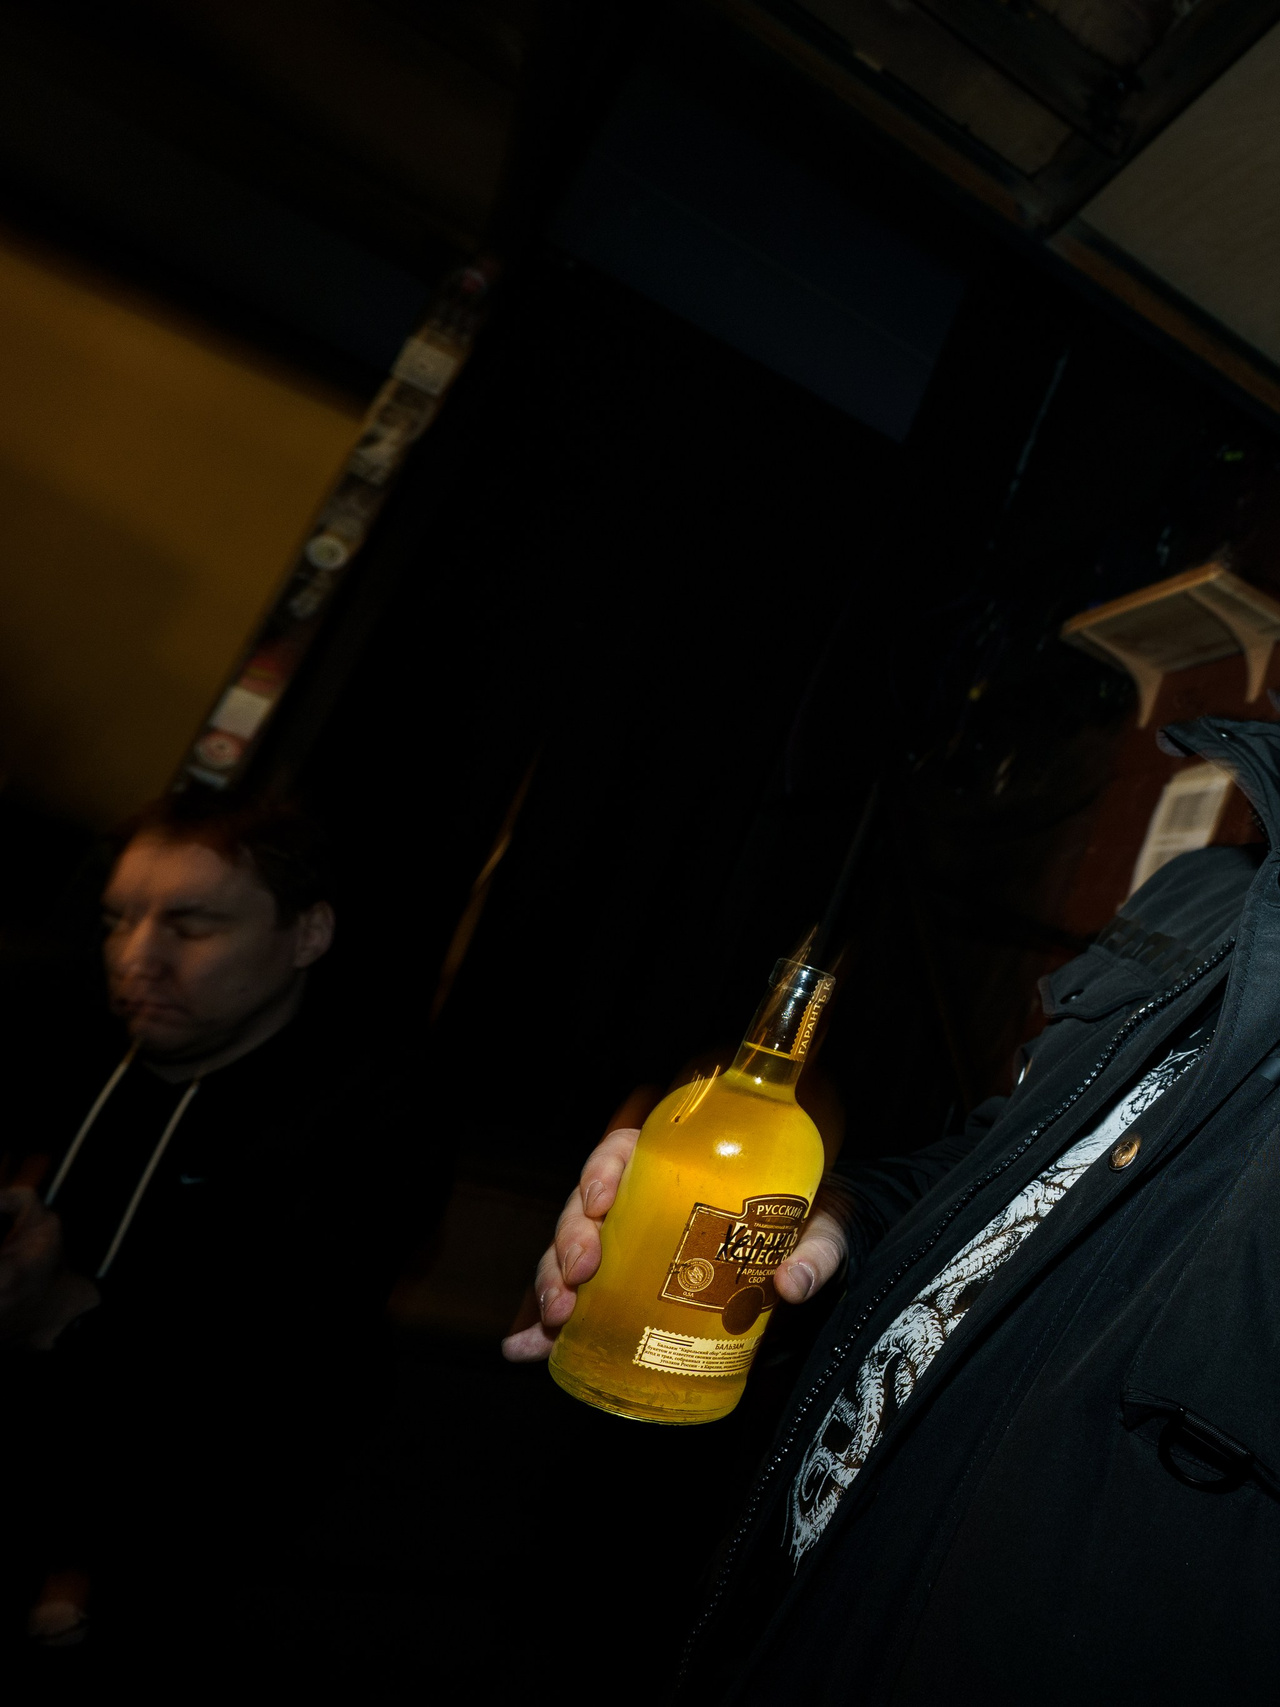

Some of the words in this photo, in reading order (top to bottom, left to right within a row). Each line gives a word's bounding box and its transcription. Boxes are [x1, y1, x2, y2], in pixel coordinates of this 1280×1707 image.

[798, 994, 827, 1055] ГАРАНТЪ
[756, 1204, 803, 1219] РУССКИЙ
[715, 1243, 795, 1266] КАЧЕСТВ
[748, 1276, 767, 1284] СБОР
